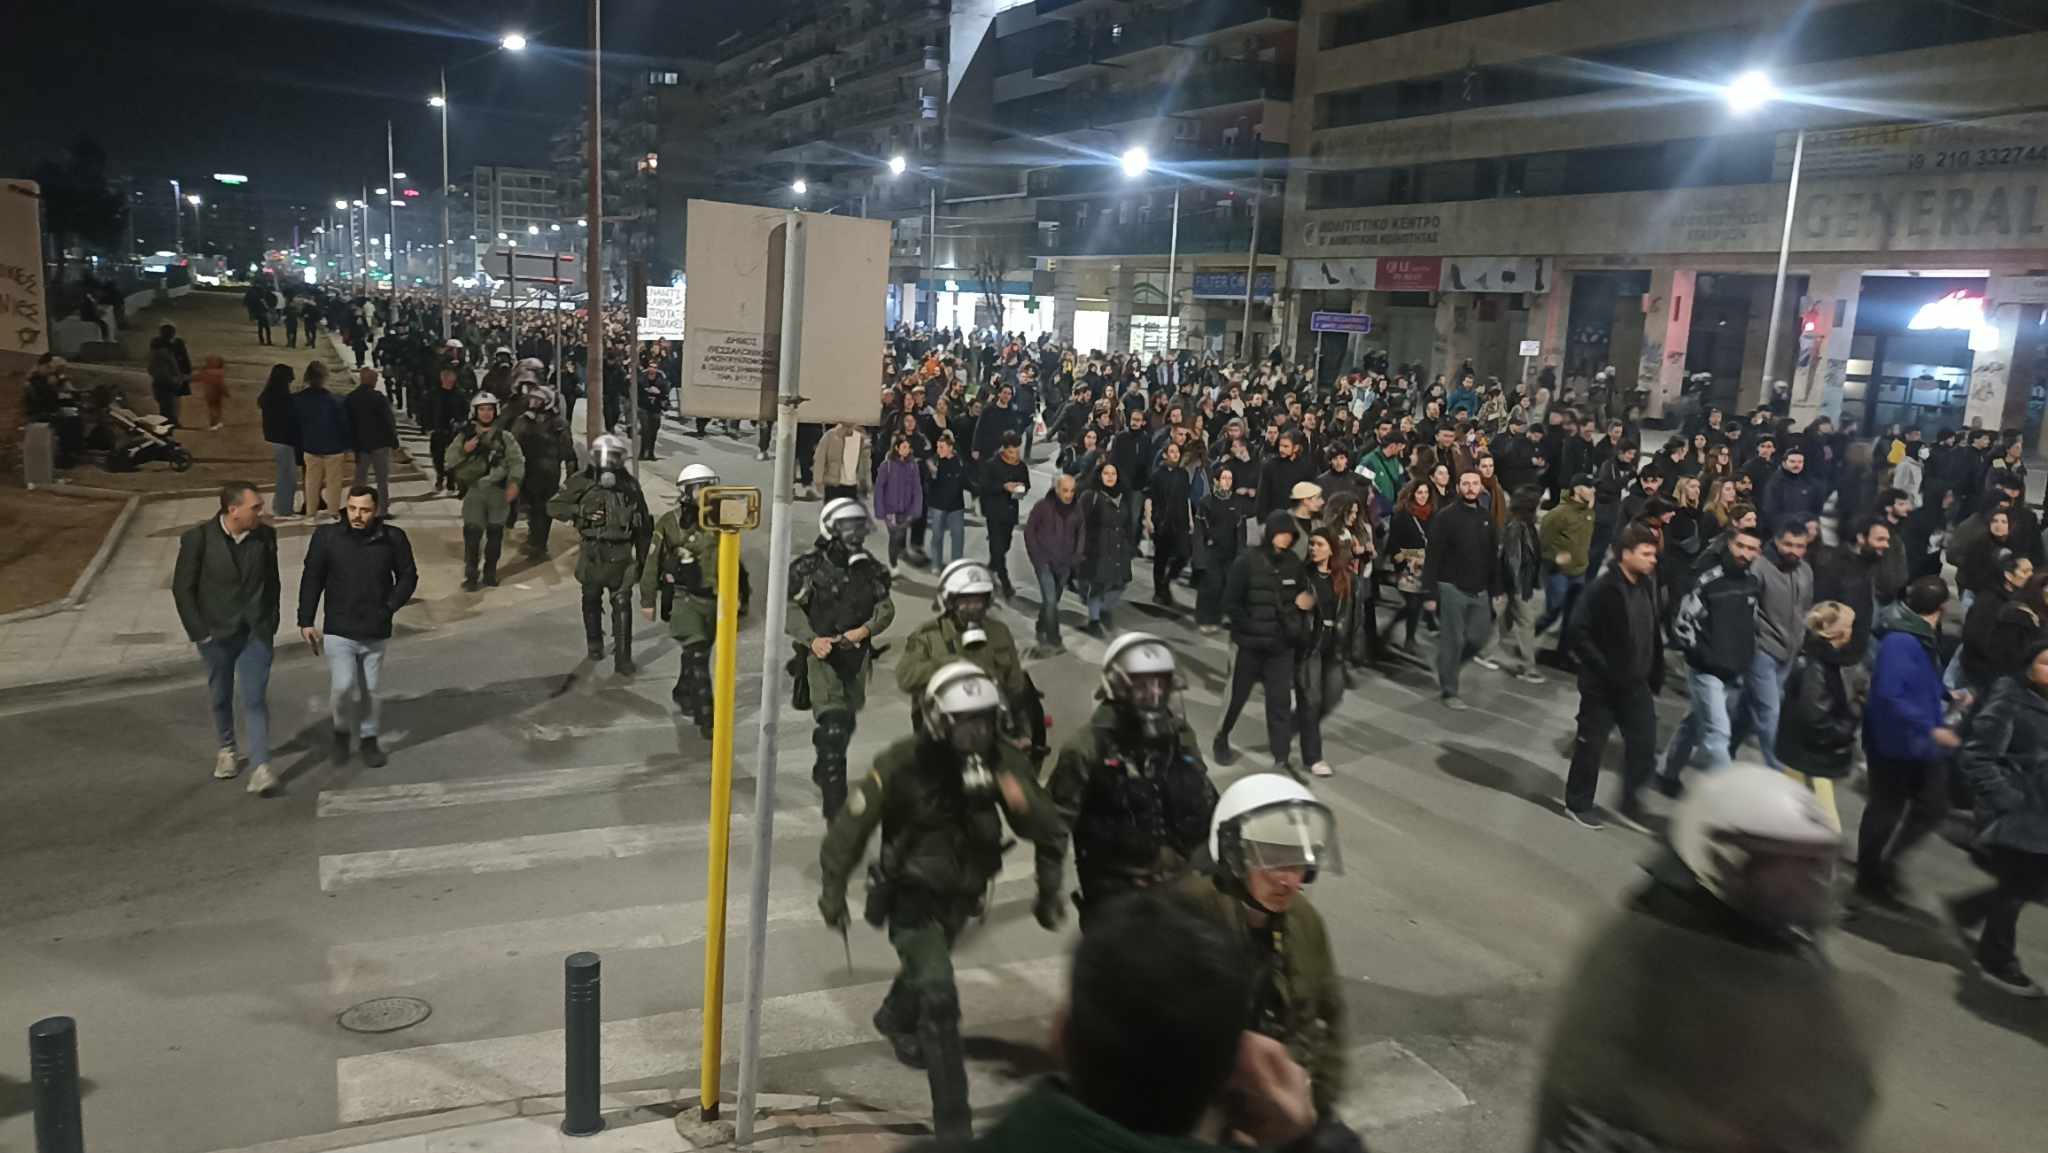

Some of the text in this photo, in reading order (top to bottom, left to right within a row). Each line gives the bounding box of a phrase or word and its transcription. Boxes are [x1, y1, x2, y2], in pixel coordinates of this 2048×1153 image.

[1936, 152, 1969, 168] 210
[1804, 185, 2044, 238] GENERAL
[1320, 215, 1440, 233] ΠΟΛΙΤΙΣΤΙΚΟ ΚΕΝΤΡΟ
